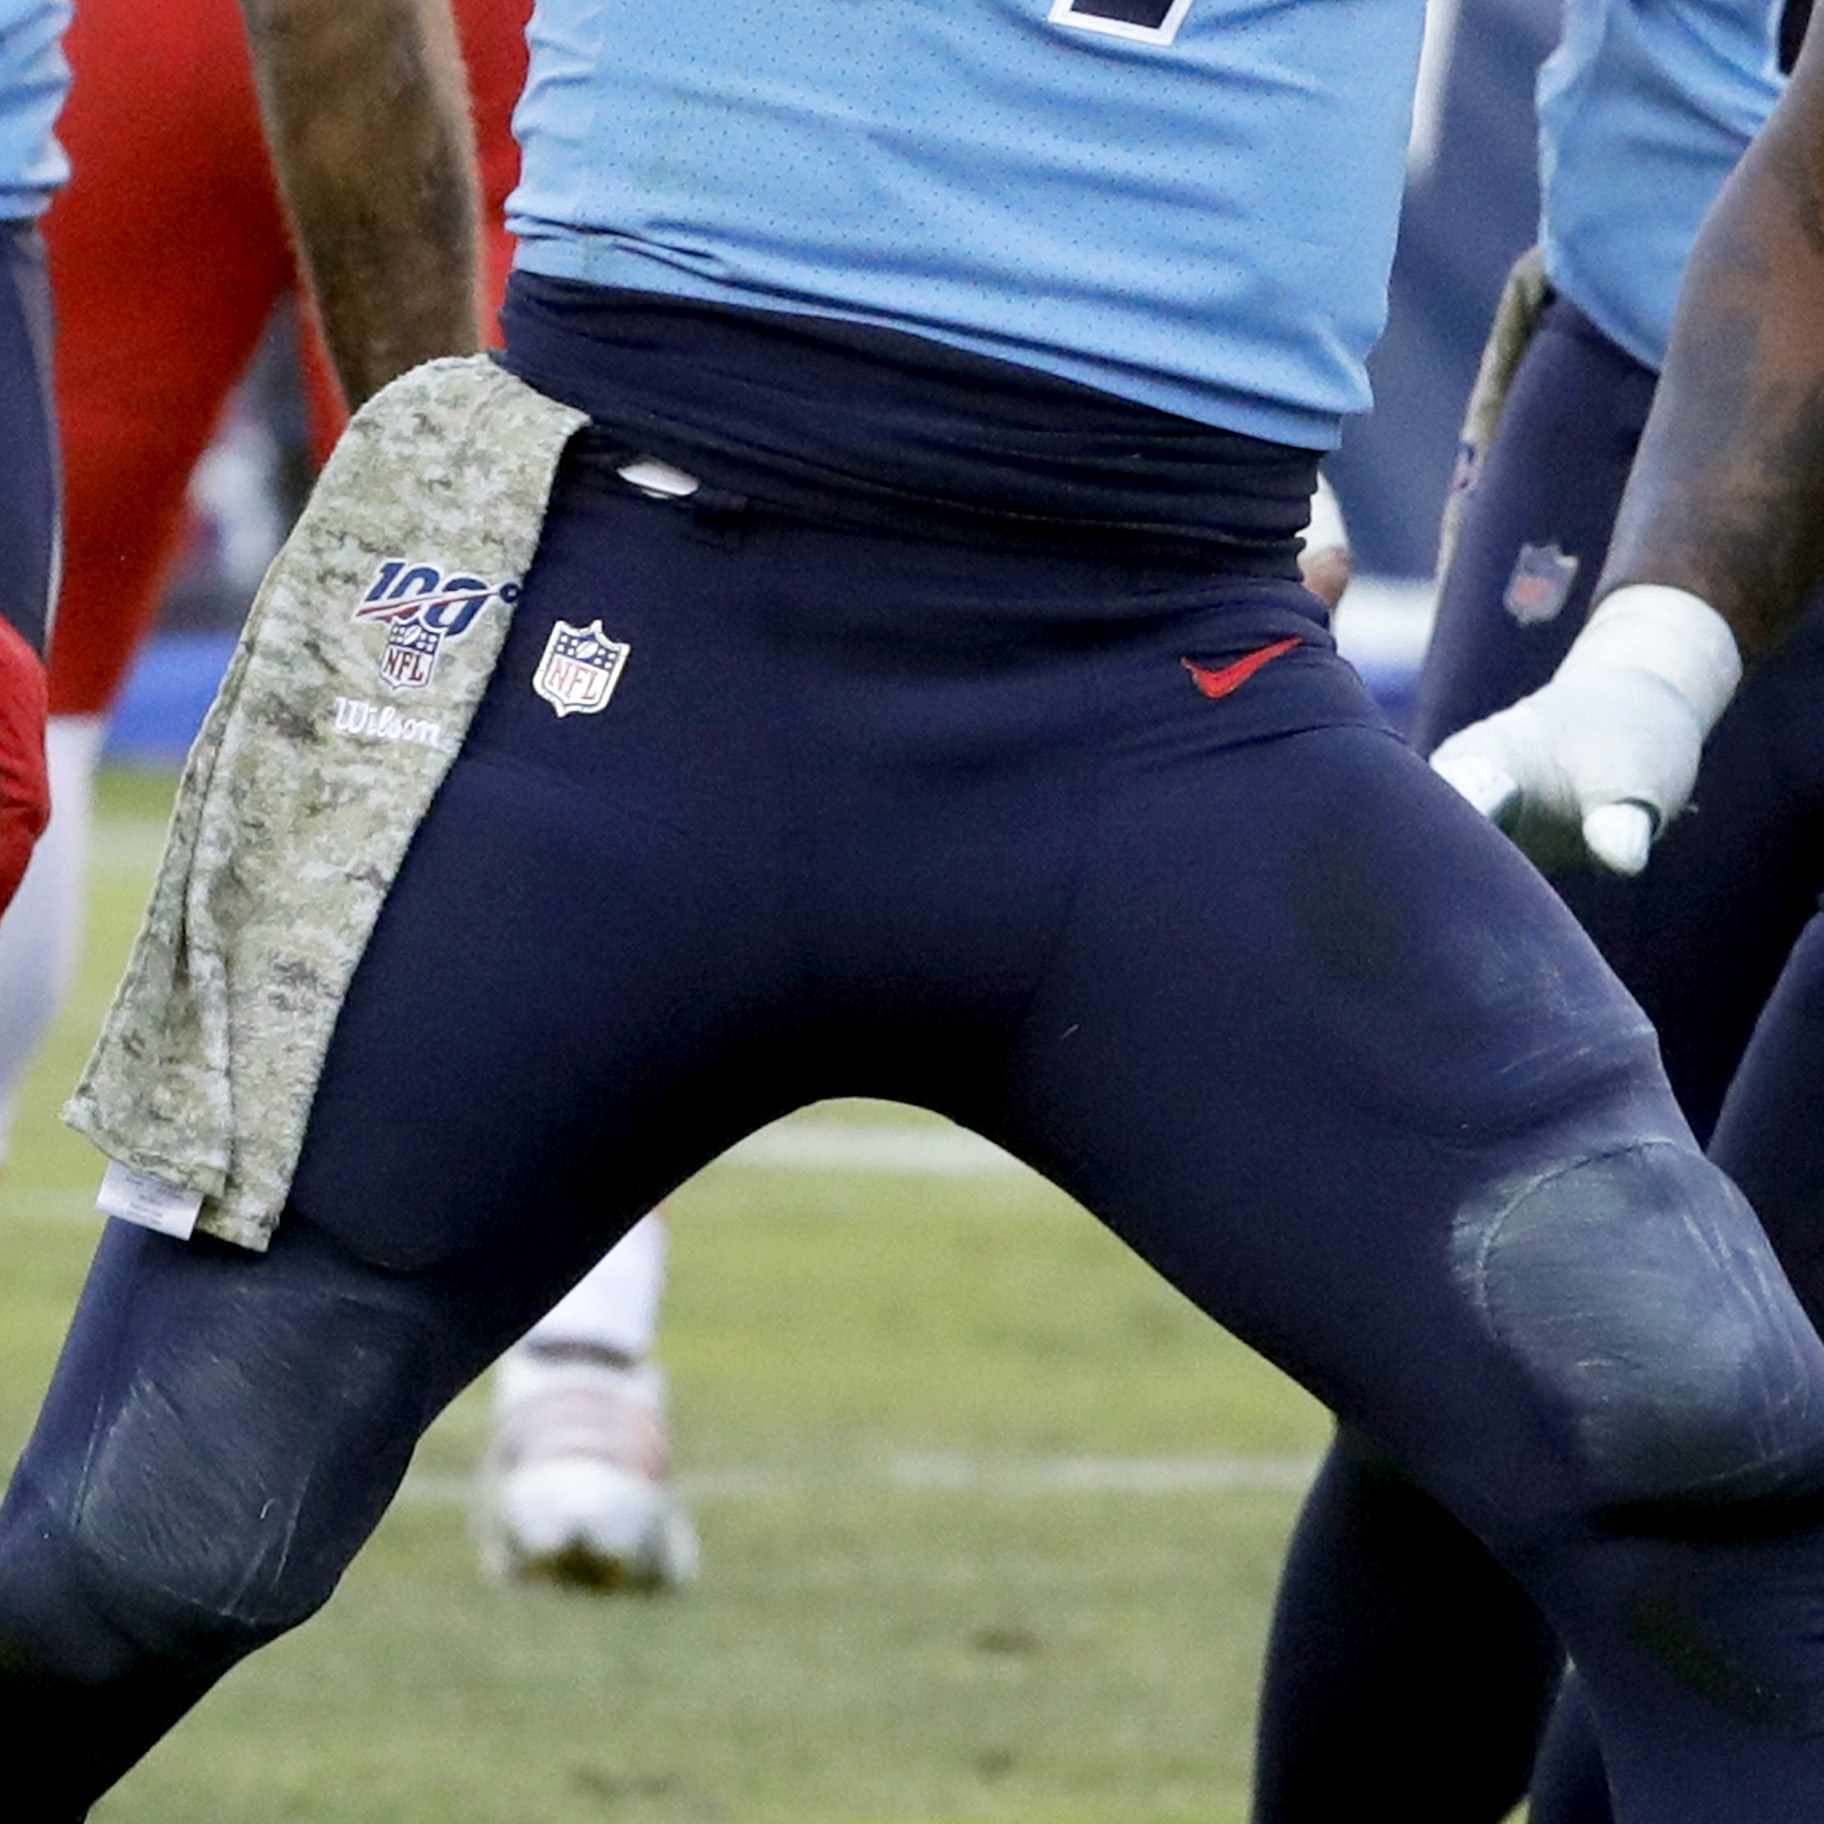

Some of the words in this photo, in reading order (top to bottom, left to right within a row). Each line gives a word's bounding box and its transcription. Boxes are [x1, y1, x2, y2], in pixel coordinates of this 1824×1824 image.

[364, 561, 489, 639] 100
[382, 647, 425, 683] NFL
[547, 656, 600, 702] NFL
[333, 696, 443, 746] Wilson
